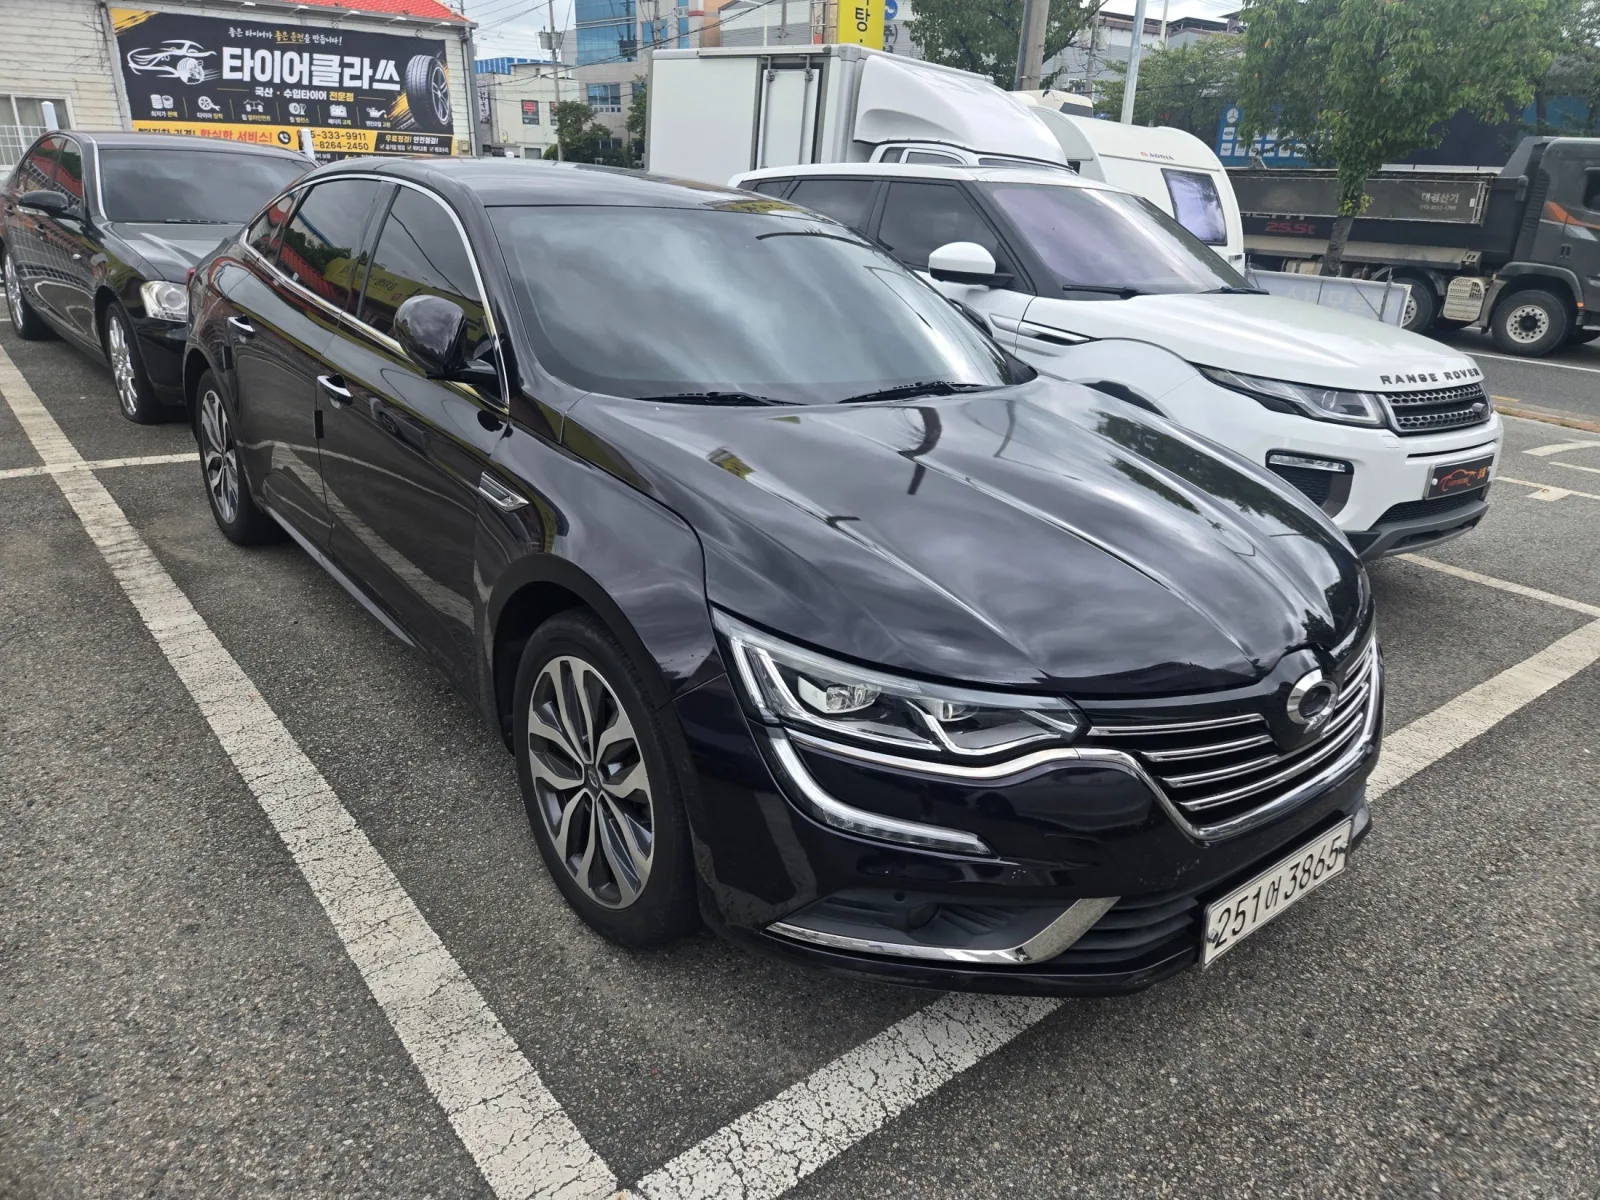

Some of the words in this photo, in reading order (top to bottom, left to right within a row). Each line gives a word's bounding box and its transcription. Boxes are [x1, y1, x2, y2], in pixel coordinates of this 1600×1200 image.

[228, 26, 243, 38] 좋은
[245, 29, 273, 39] 타이어가
[274, 30, 289, 41] 좋은
[290, 31, 311, 44] 운전을
[312, 34, 342, 45] 만듭니다!
[222, 46, 401, 91] 타이어클라쓰
[255, 87, 274, 98] 국산
[283, 88, 327, 100] 수입타이어
[329, 91, 354, 102] 전문점
[237, 130, 273, 143] 서비스!
[297, 129, 367, 141] 5-333-9911
[386, 134, 412, 143] 무료점검!
[413, 136, 439, 145] 안전점검!
[312, 141, 369, 151] -8264-2450
[1380, 372, 1439, 385] RANGE
[1443, 367, 1481, 380] ROVER
[1214, 875, 1282, 950] 251어
[1284, 834, 1342, 900] 3865
